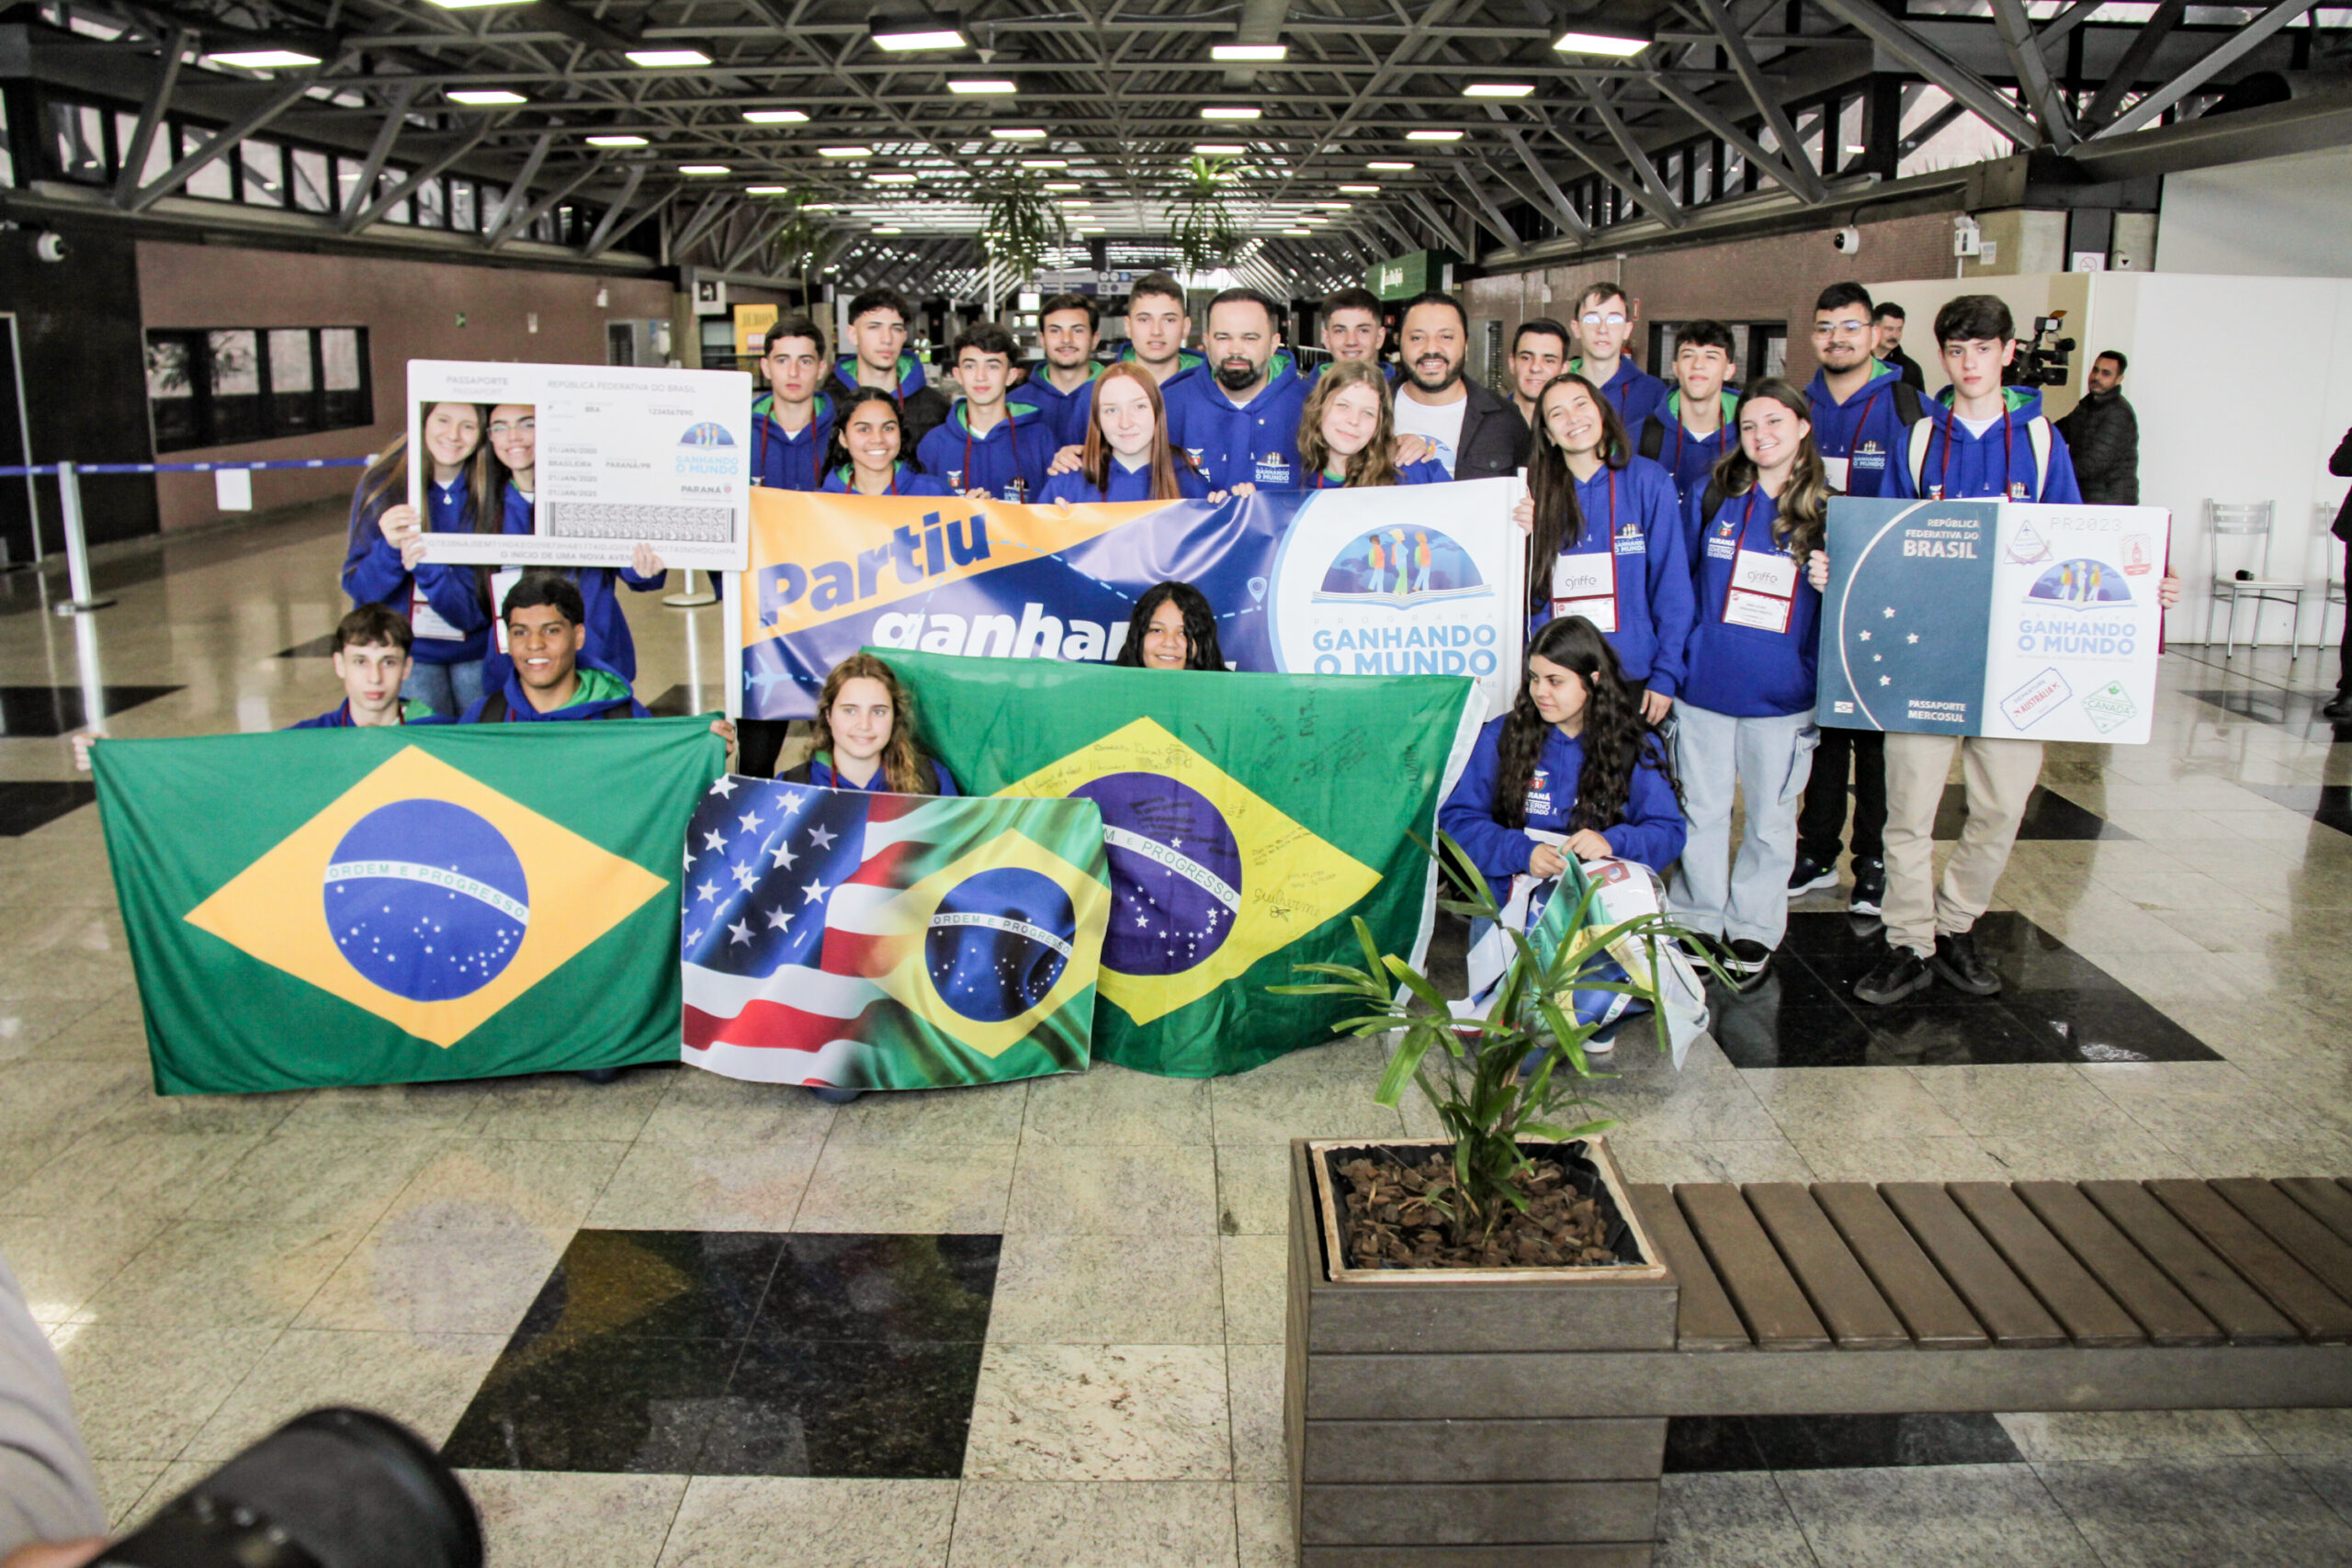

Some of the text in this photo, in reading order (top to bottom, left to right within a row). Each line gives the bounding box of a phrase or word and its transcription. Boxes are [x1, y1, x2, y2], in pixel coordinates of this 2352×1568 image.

[446, 375, 508, 386] PASSAPORTE
[548, 379, 695, 393] REPÚBLICA FEDERATIVA DO BRASIL
[548, 459, 592, 468] BRASILEIRA
[676, 456, 739, 464] GANHANDO
[676, 464, 739, 475] O MUNDO
[681, 484, 722, 493] PARANÁ
[1927, 517, 1980, 528] REPÚBLICA
[2050, 516, 2123, 532] PR2023
[1905, 529, 1979, 540] FEDERATIVA DO
[1903, 539, 1978, 558] BRASIL
[556, 552, 576, 560] UMA
[758, 511, 991, 629] Partiu
[1747, 570, 1778, 584] griffe
[1566, 575, 1597, 590] griffe
[2018, 619, 2137, 638] GANHANDO
[1313, 624, 1497, 651] GANHANDO
[2018, 635, 2136, 656] O MUNDO
[1314, 649, 1498, 676] O MUNDO
[1908, 700, 1966, 712] PASSAPORTE
[2087, 699, 2131, 714] CANADA
[1907, 709, 1965, 723] MERCOSUL
[1527, 791, 1551, 801] RANÁ
[1141, 840, 1235, 902] PROGRESSO
[328, 863, 525, 919] ORDEM E PROGRESSO
[933, 914, 1070, 954] ORDEM E PROGRESSO
